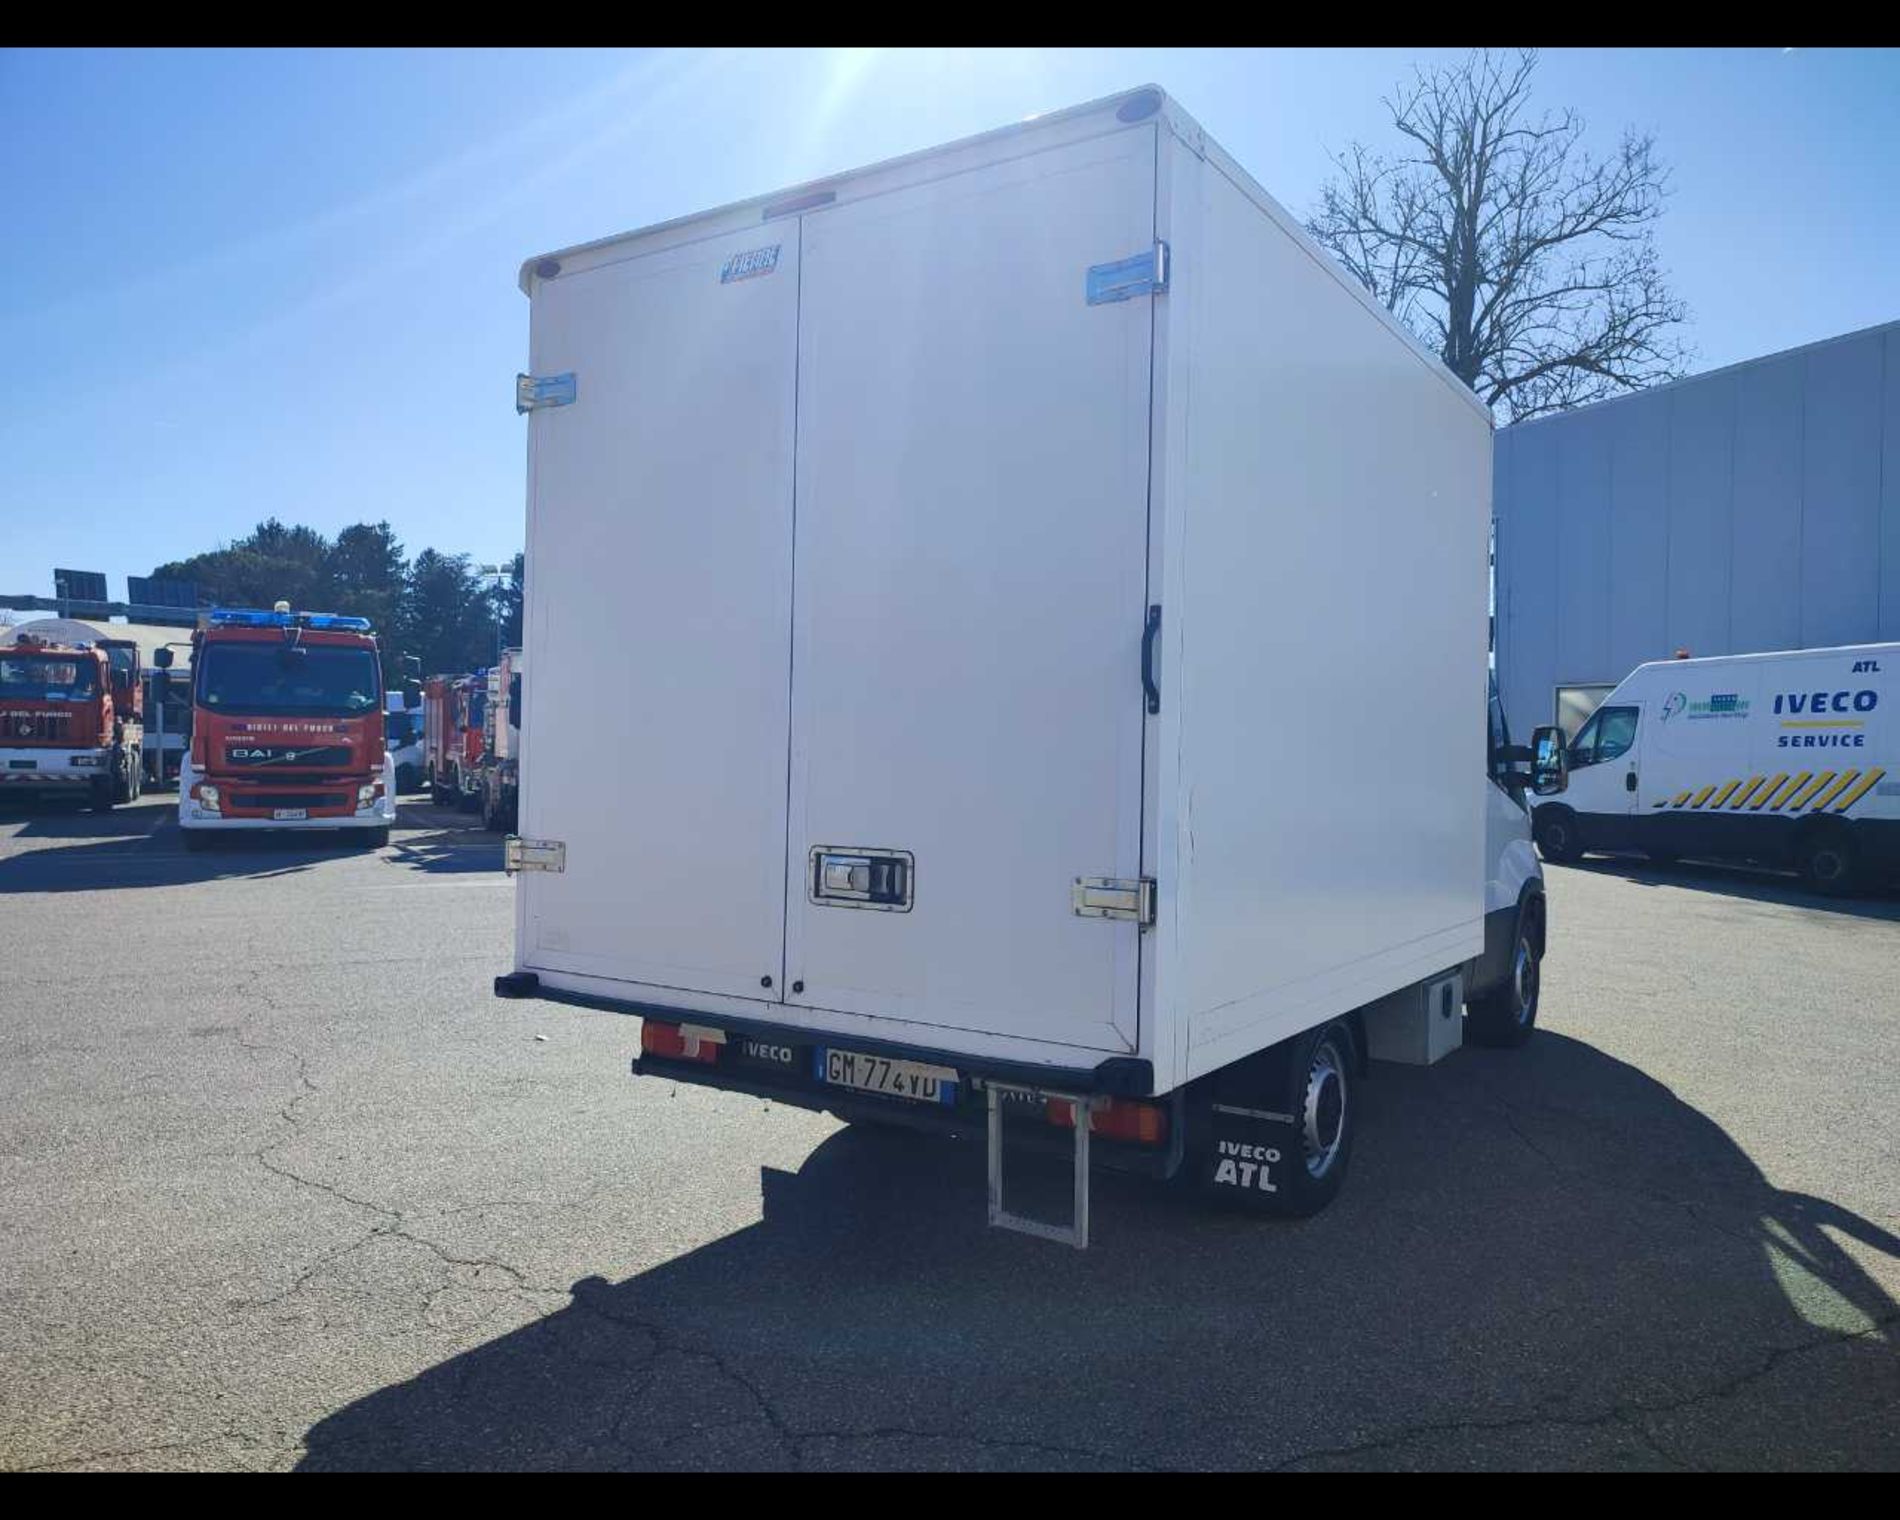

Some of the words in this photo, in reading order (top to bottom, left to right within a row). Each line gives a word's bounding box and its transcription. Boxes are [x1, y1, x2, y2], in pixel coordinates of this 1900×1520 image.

[1852, 660, 1881, 673] ATL
[1773, 690, 1879, 715] IVECO
[1777, 734, 1865, 748] SERVICE
[232, 749, 272, 758] BAI
[742, 1041, 793, 1063] IVECO
[1218, 1140, 1281, 1163] IVECO
[1214, 1158, 1278, 1193] ATL
